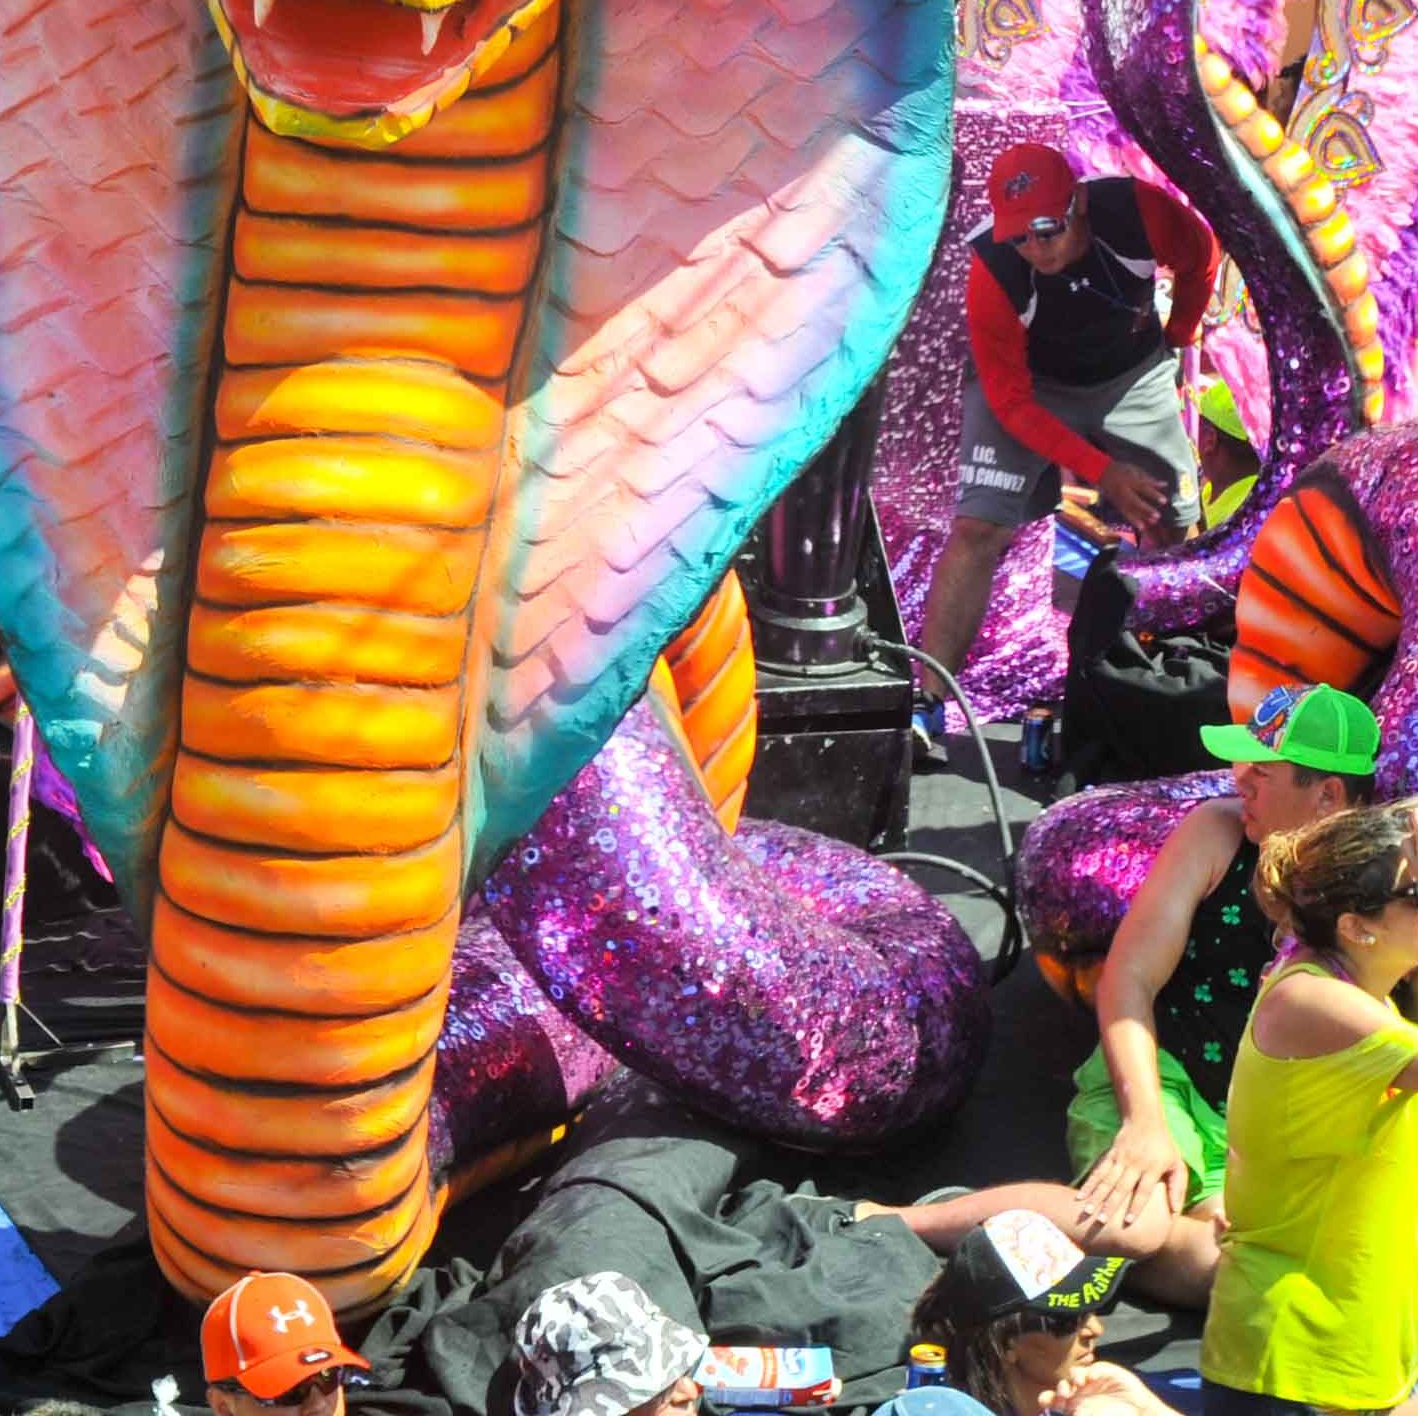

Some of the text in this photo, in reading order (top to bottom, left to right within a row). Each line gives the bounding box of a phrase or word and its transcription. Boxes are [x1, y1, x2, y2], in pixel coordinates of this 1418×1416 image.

[972, 445, 997, 464] LIC.
[975, 467, 1026, 493] CHAVEZ
[1048, 1292, 1080, 1308] THE
